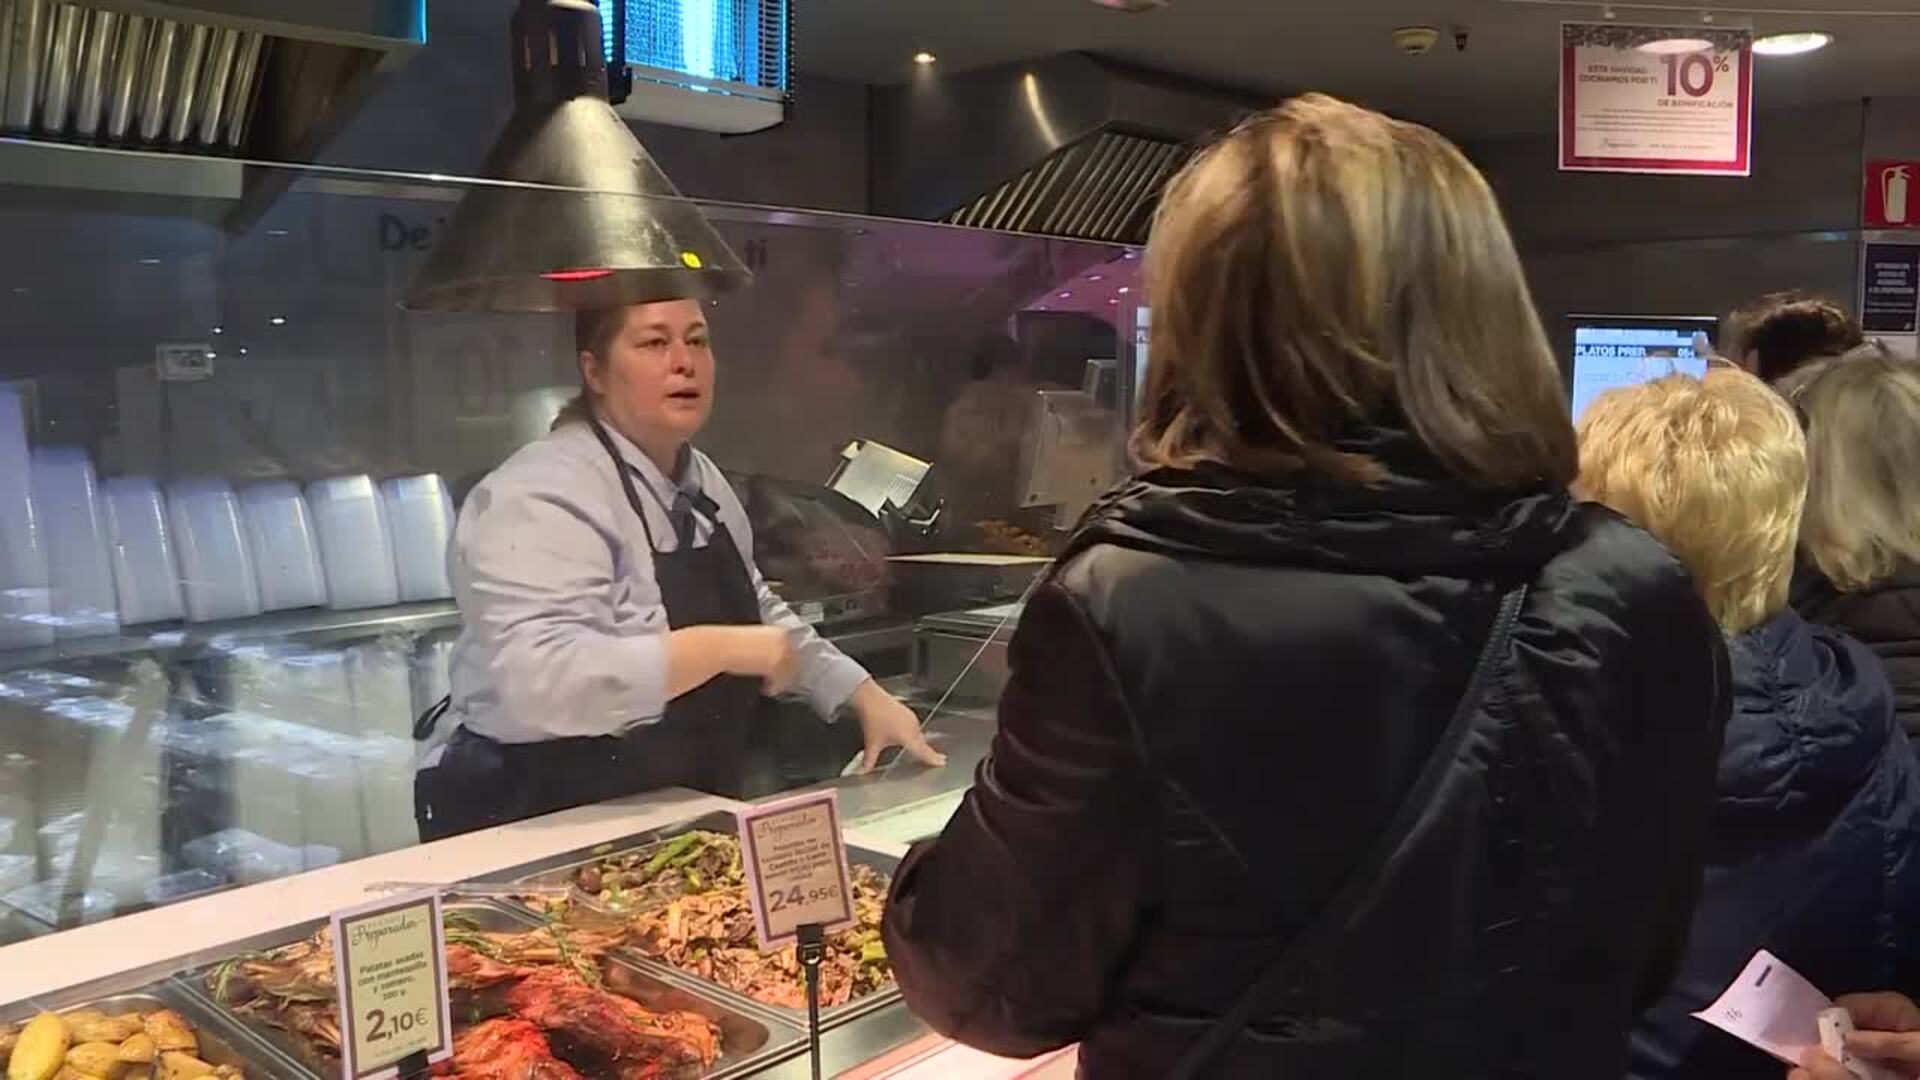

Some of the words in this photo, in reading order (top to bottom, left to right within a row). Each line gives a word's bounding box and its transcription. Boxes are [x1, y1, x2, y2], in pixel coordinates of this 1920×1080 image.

[1579, 74, 1630, 84] COCINAMOS
[1631, 76, 1649, 84] POR
[1657, 98, 1669, 107] DE
[1671, 98, 1733, 109] BONIFICACIÓN
[1576, 345, 1616, 358] PLATOS
[360, 961, 393, 975] Patatas
[395, 951, 424, 965] asadas
[358, 975, 375, 987] con
[377, 960, 428, 982] mantequilla
[366, 1007, 429, 1043] 2,10€
